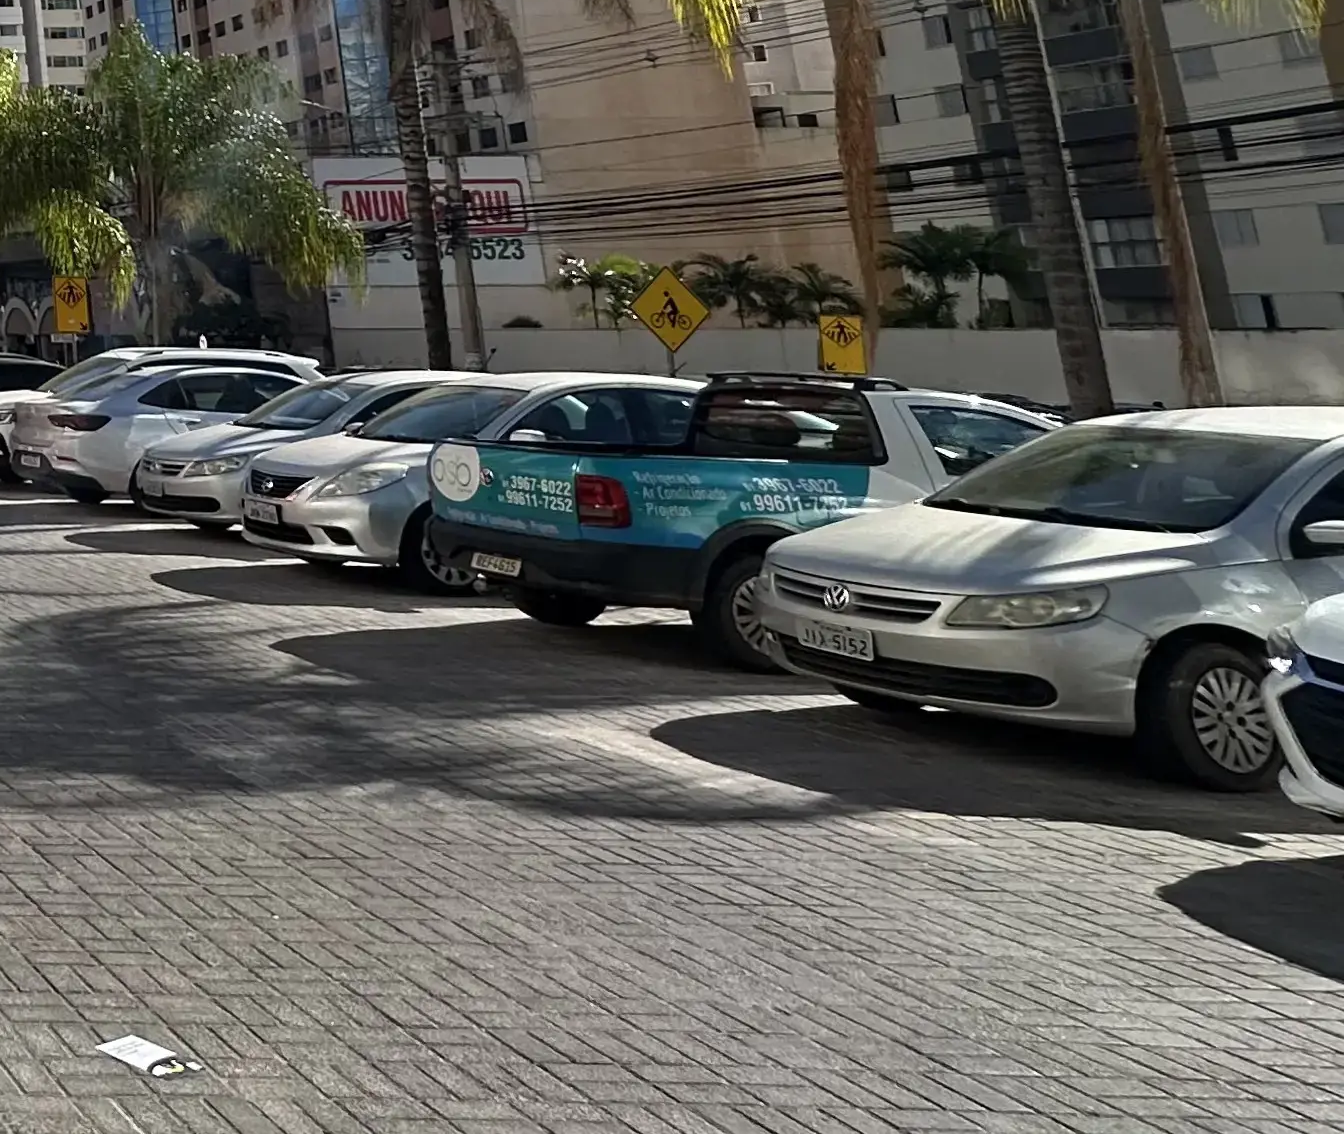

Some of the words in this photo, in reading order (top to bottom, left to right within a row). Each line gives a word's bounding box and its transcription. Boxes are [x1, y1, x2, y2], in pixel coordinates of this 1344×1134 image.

[510, 475, 572, 496] 3967-6022
[752, 477, 843, 495] 3967-6022
[505, 489, 574, 513] 99611-7252
